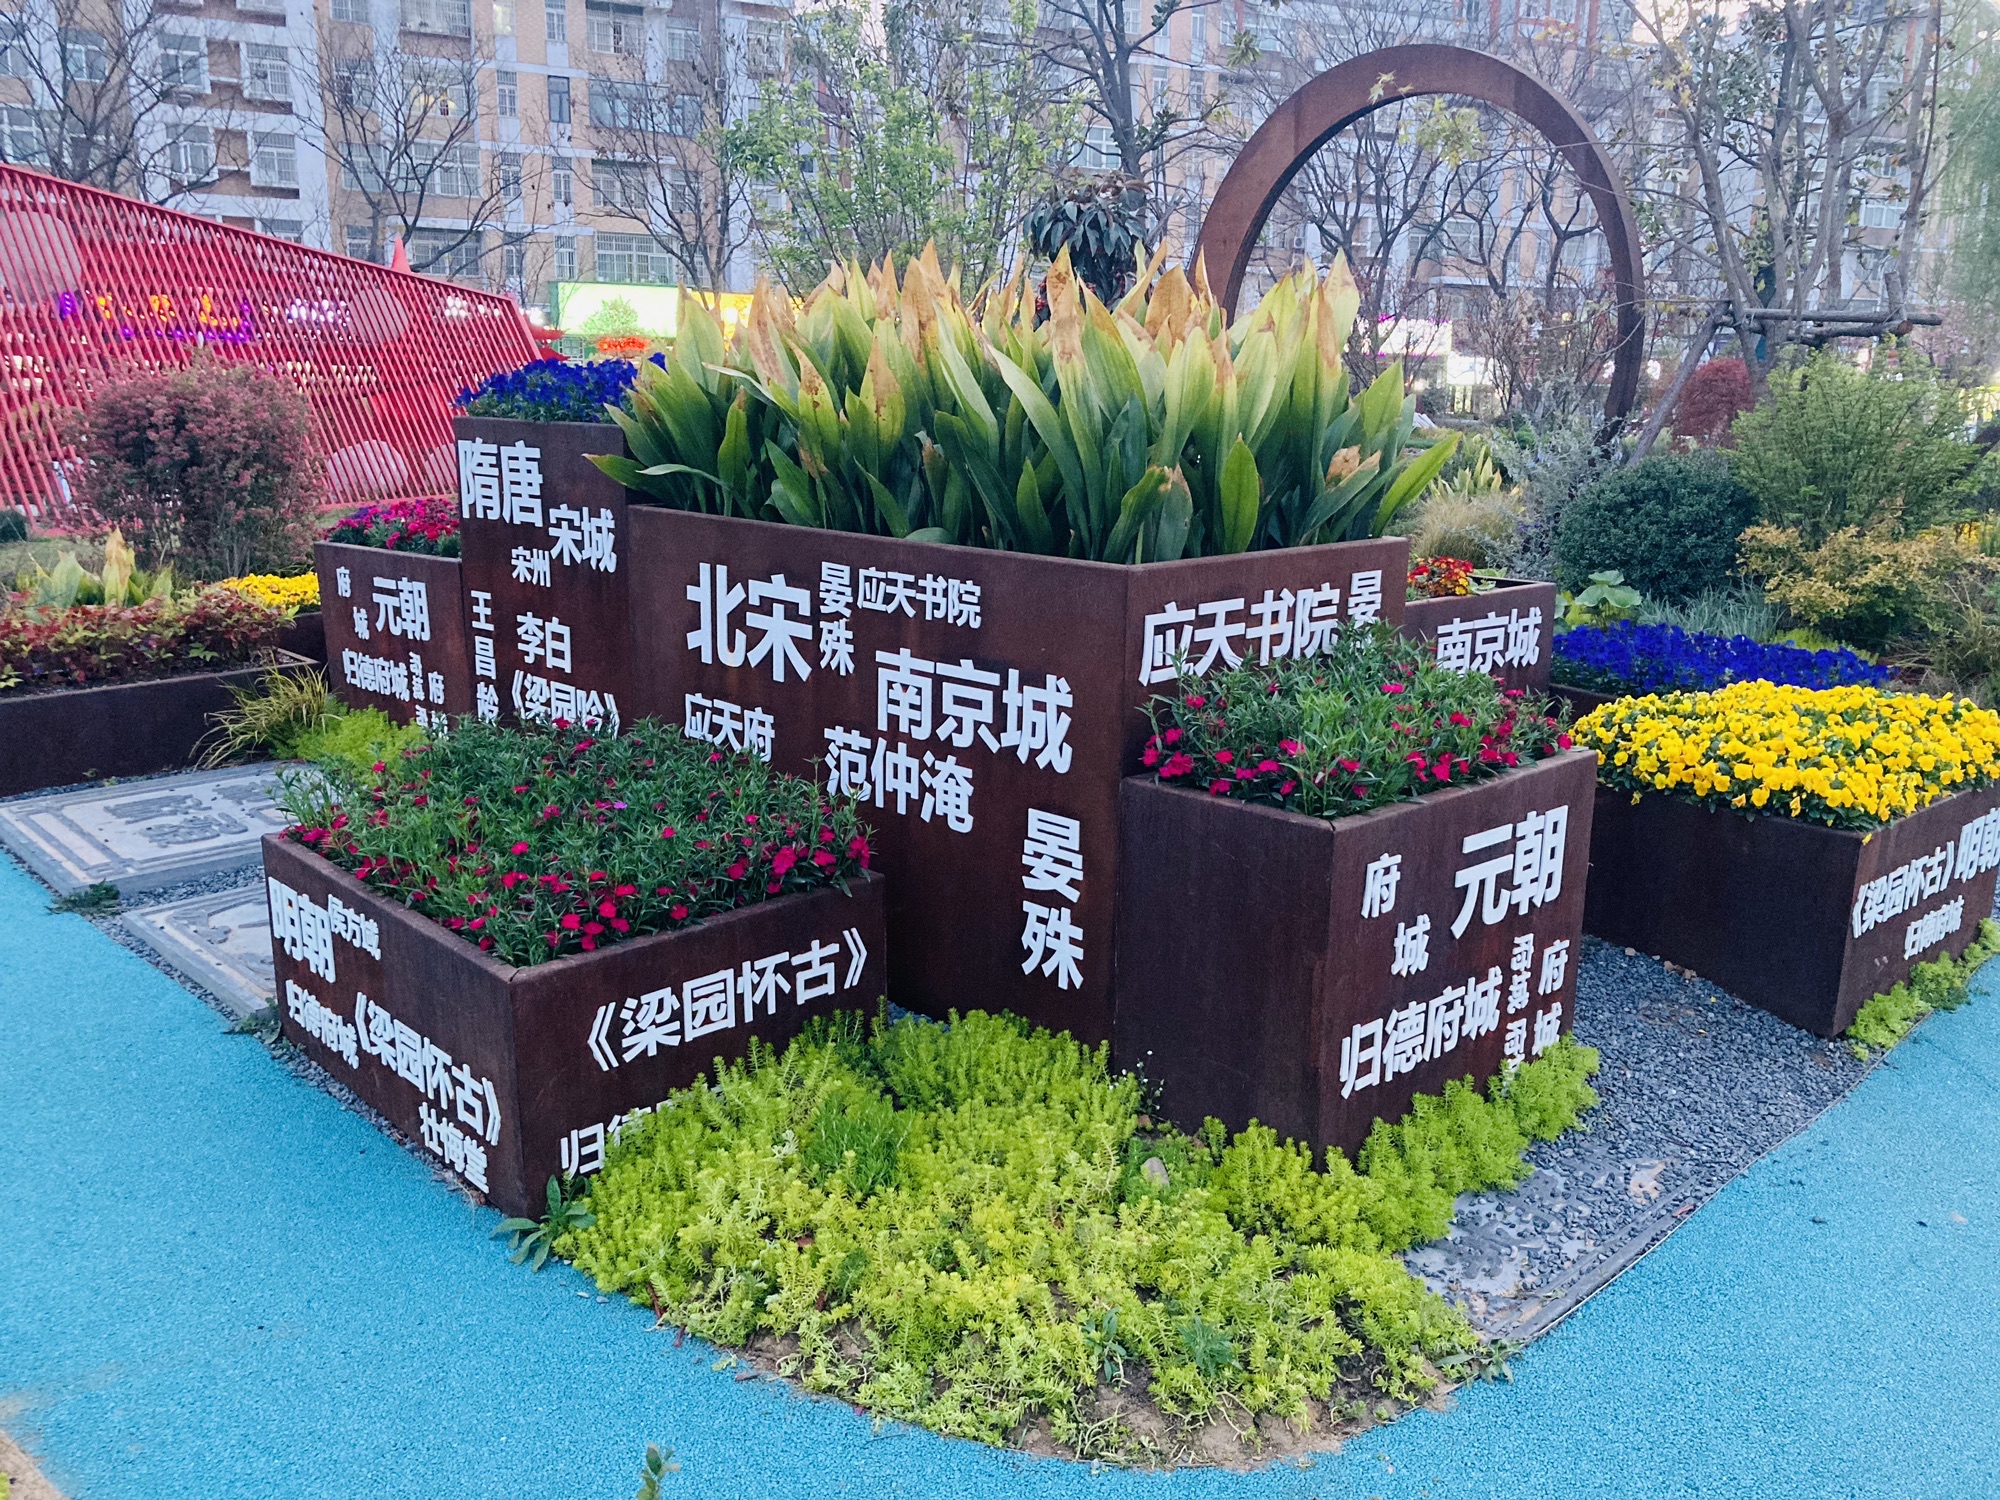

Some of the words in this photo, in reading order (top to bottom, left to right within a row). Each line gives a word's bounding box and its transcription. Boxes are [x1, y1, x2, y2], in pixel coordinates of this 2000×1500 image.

[458, 437, 542, 527] 隋唐
[512, 546, 550, 587] 宋州
[549, 504, 616, 572] 宋城
[373, 577, 430, 641] 元朝
[515, 612, 571, 676] 李白
[687, 563, 812, 682] 北宋
[820, 562, 854, 675] 晏殊
[857, 567, 981, 628] 应天书院
[1139, 583, 1339, 686] 应天书院
[1437, 607, 1542, 676] 南京城
[343, 648, 410, 701] 归德府城
[471, 591, 498, 723] 王昌龄
[685, 693, 775, 761] 应天府
[876, 648, 1072, 773] 南京城
[824, 726, 973, 832] 范仲淹
[1022, 808, 1083, 989] 晏殊
[1451, 805, 1569, 939] 元朝
[1852, 841, 1956, 938] 《梁园怀古》
[267, 877, 335, 983] 明朝
[328, 894, 380, 960] 侯方域
[1904, 895, 1964, 960] 归德府城
[286, 980, 360, 1069] 归德府城
[588, 928, 867, 1071] 《梁园怀古》
[1340, 965, 1502, 1099] 归德府城
[353, 992, 501, 1145] 《梁园怀古》
[419, 1102, 490, 1193] 壮悔堂
